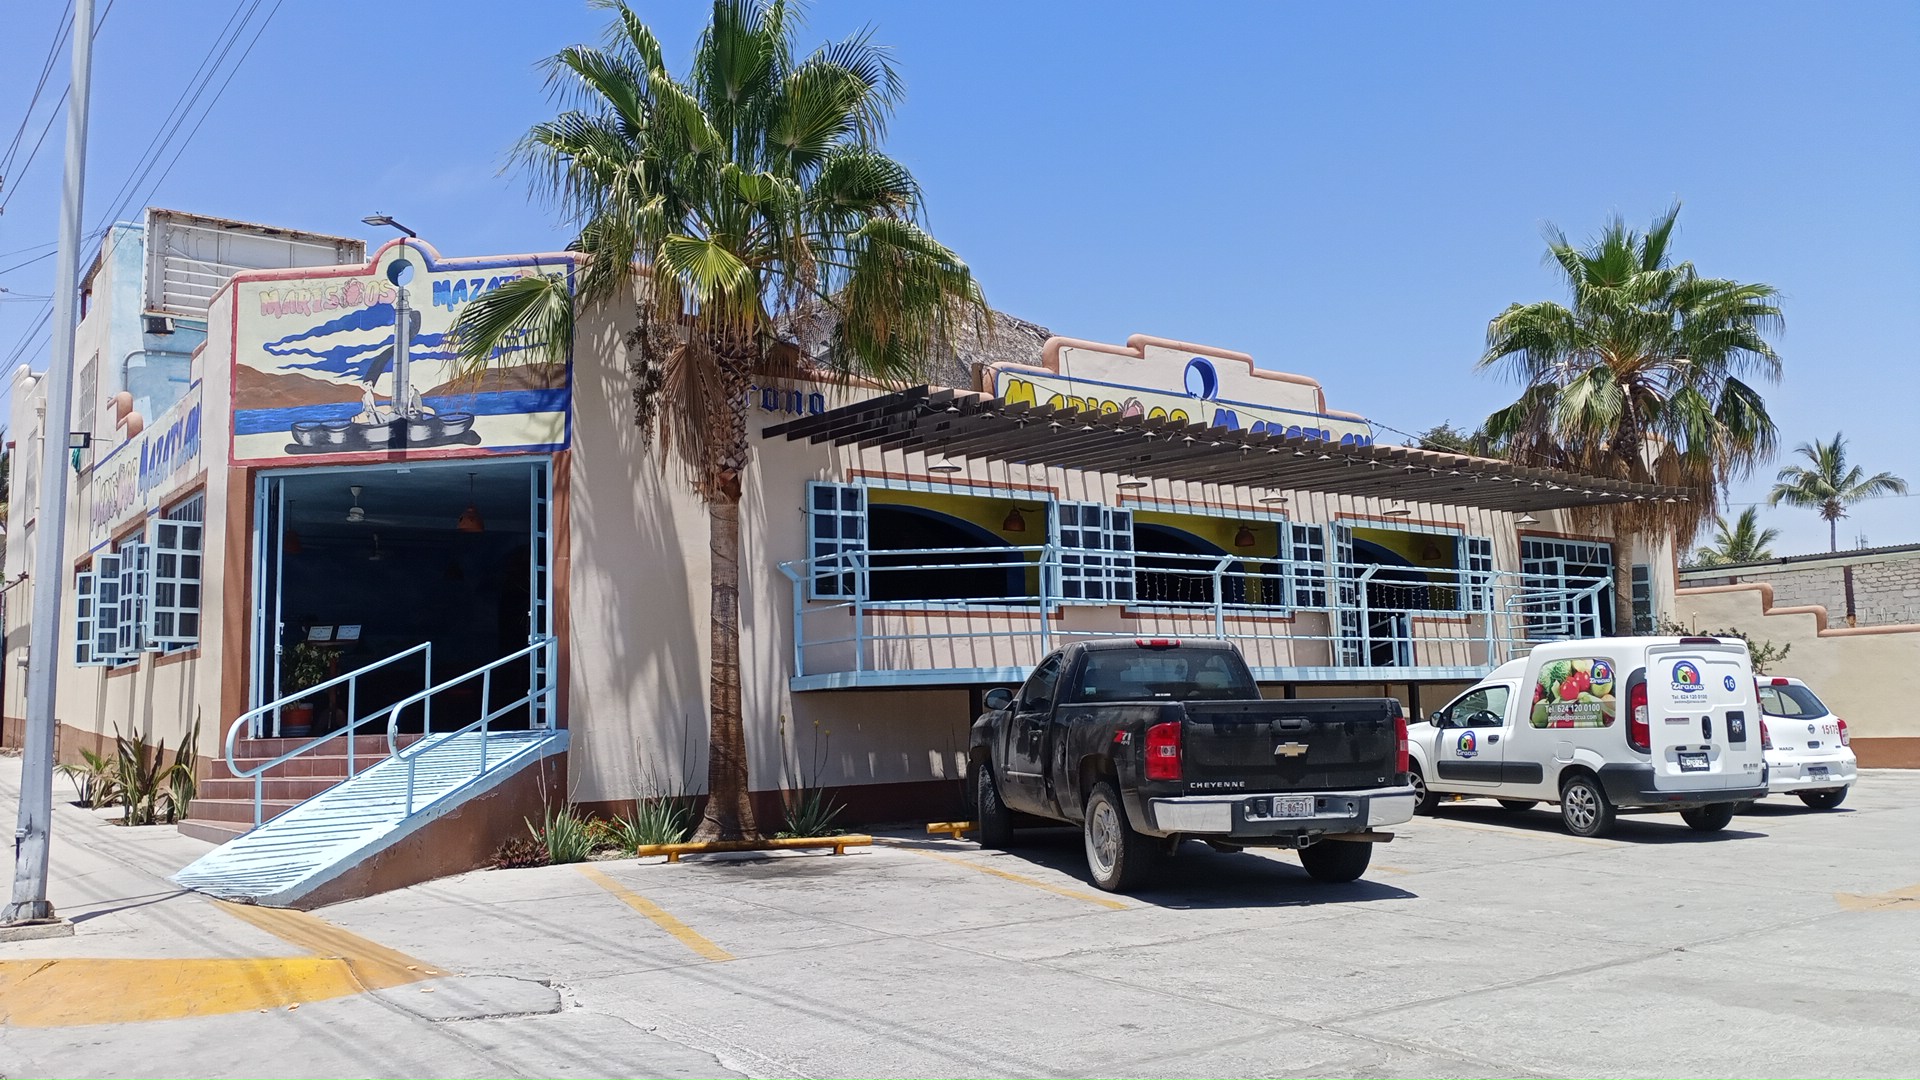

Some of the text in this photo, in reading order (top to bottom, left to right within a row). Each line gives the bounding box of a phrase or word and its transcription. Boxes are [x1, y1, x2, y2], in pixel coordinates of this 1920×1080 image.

[1724, 679, 1735, 689] 16
[1557, 704, 1569, 713] 624
[1571, 704, 1583, 712] 120
[1583, 703, 1600, 712] 0100
[1113, 730, 1132, 743] Z71
[1190, 781, 1245, 789] CHEYENNE
